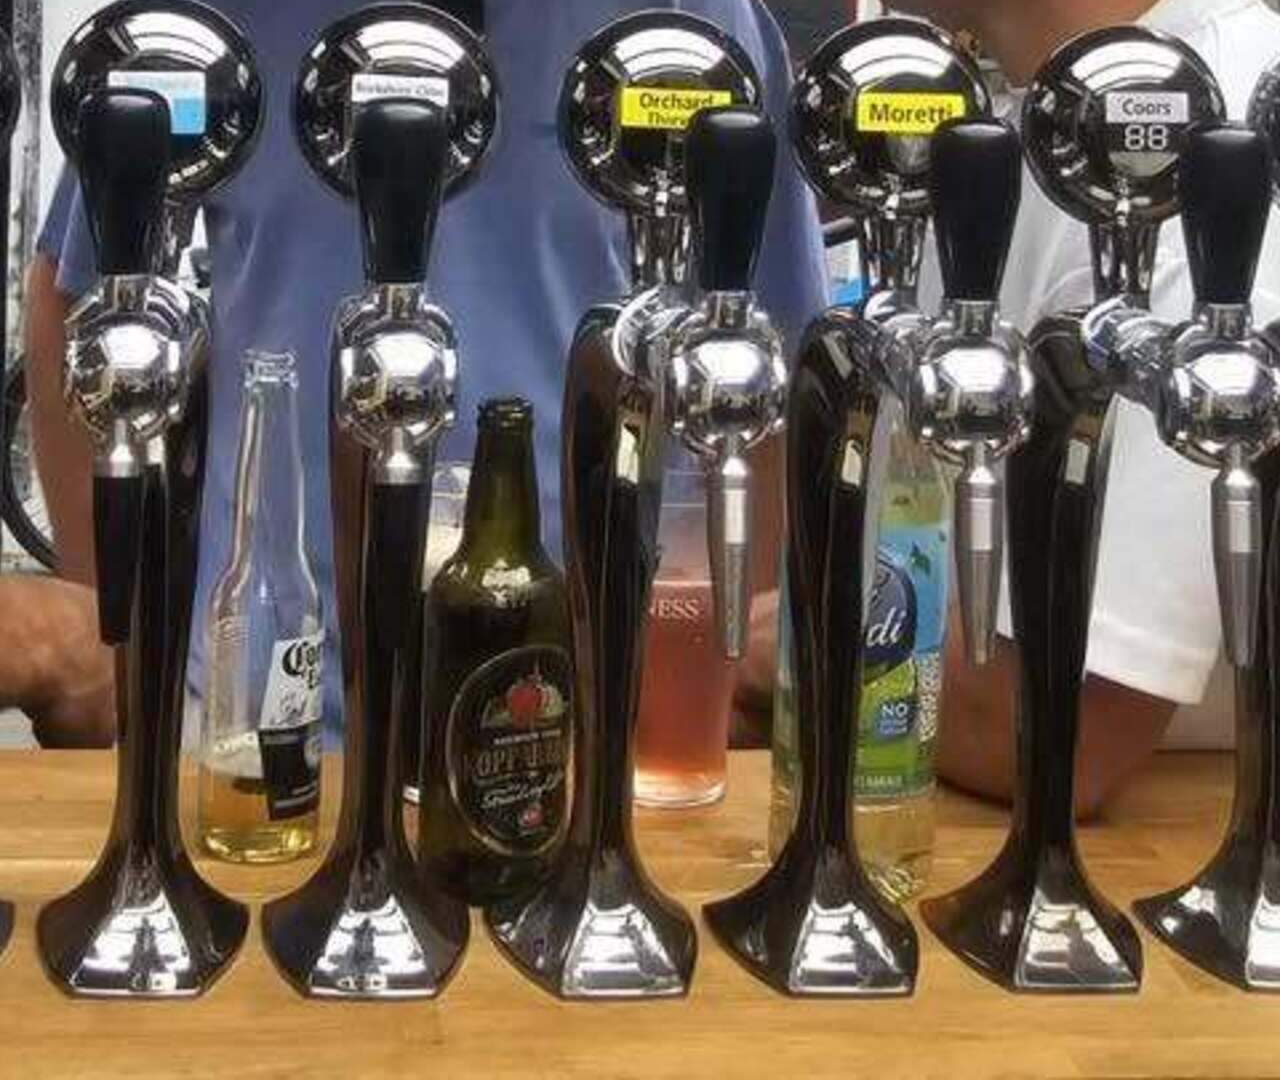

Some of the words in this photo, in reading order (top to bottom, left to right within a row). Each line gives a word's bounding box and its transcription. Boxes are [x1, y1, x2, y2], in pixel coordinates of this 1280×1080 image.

[639, 92, 713, 109] Orchard
[1122, 98, 1172, 115] Coors
[870, 103, 953, 124] Moretti
[1124, 124, 1168, 151] 88
[648, 599, 701, 620] ESS
